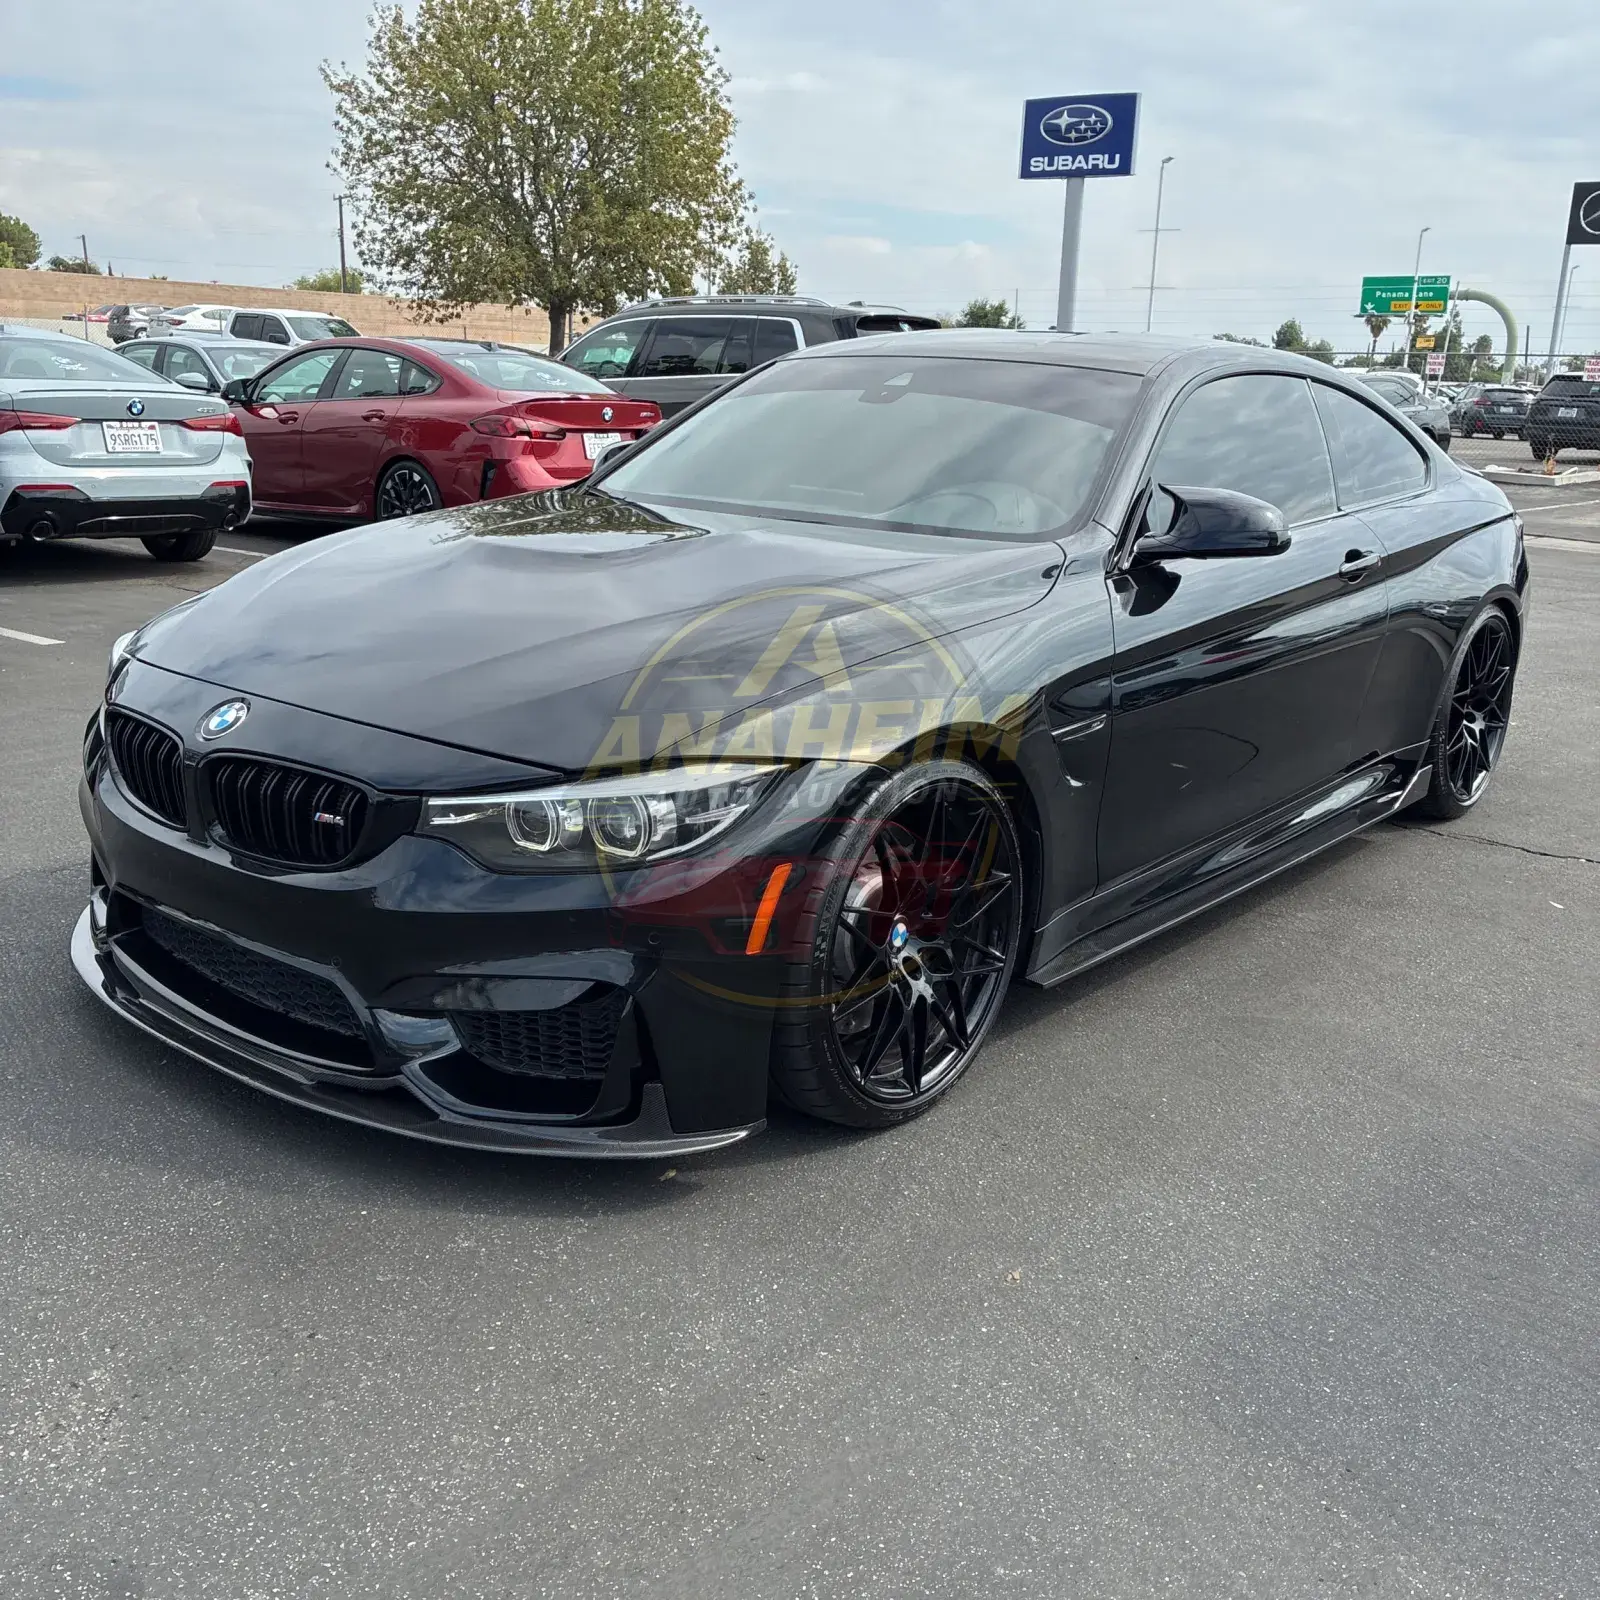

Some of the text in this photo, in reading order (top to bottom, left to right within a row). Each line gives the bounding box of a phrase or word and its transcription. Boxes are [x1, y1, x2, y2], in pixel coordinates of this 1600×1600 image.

[1029, 153, 1120, 172] SUBARU
[1375, 289, 1434, 298] Panama ane
[110, 433, 158, 446] 9SRG175
